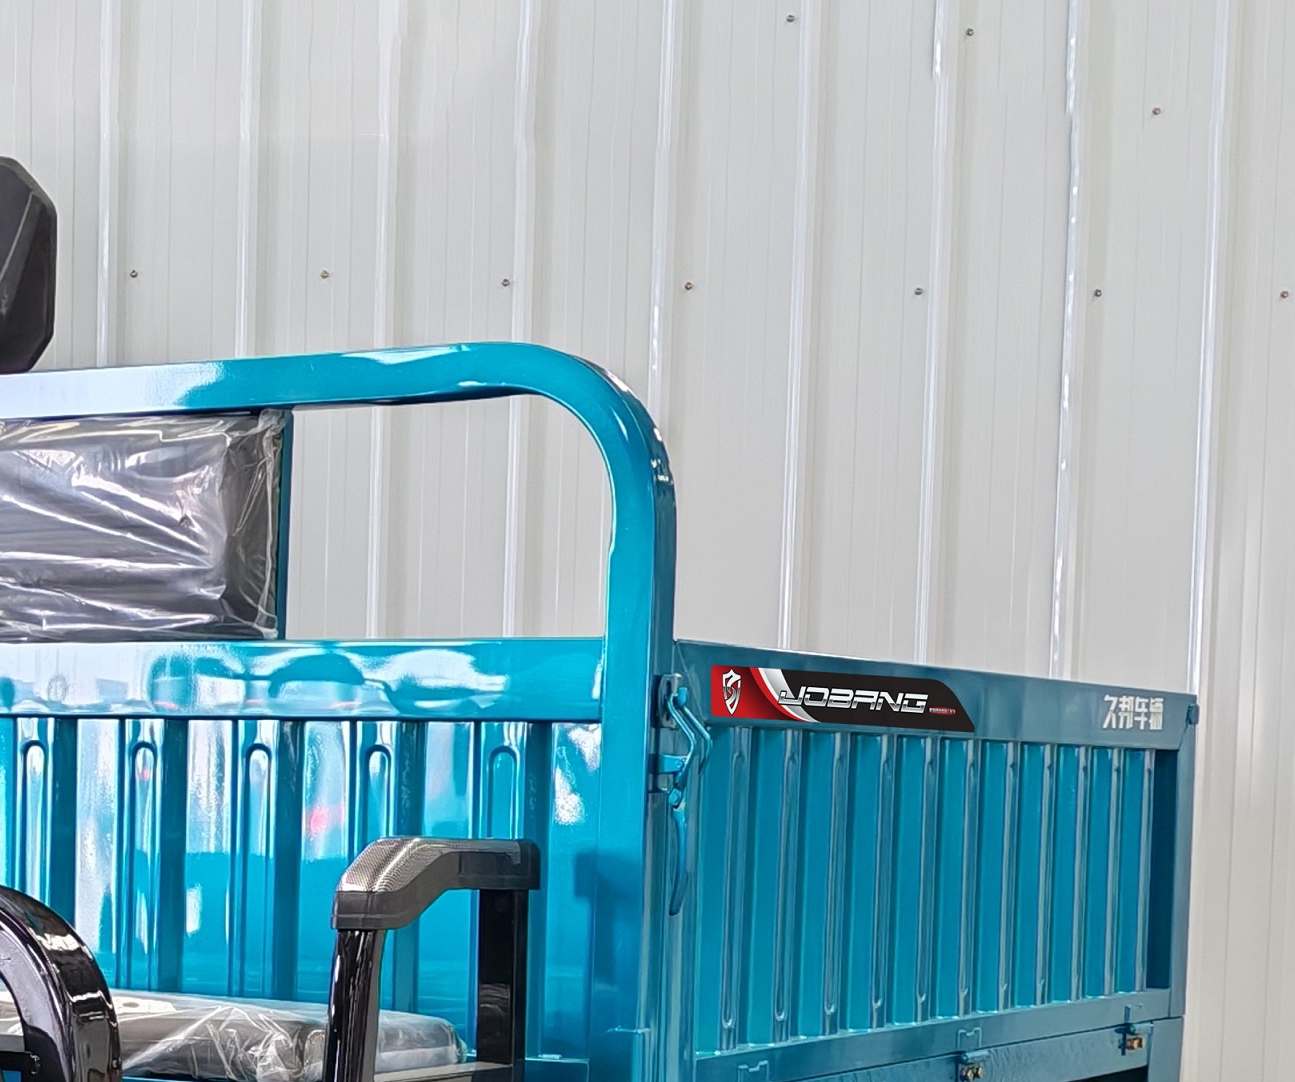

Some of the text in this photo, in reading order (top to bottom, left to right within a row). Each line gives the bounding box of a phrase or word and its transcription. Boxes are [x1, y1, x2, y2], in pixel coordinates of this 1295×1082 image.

[778, 685, 929, 714] JOBANG
[1102, 694, 1164, 730] 久邦车辆
